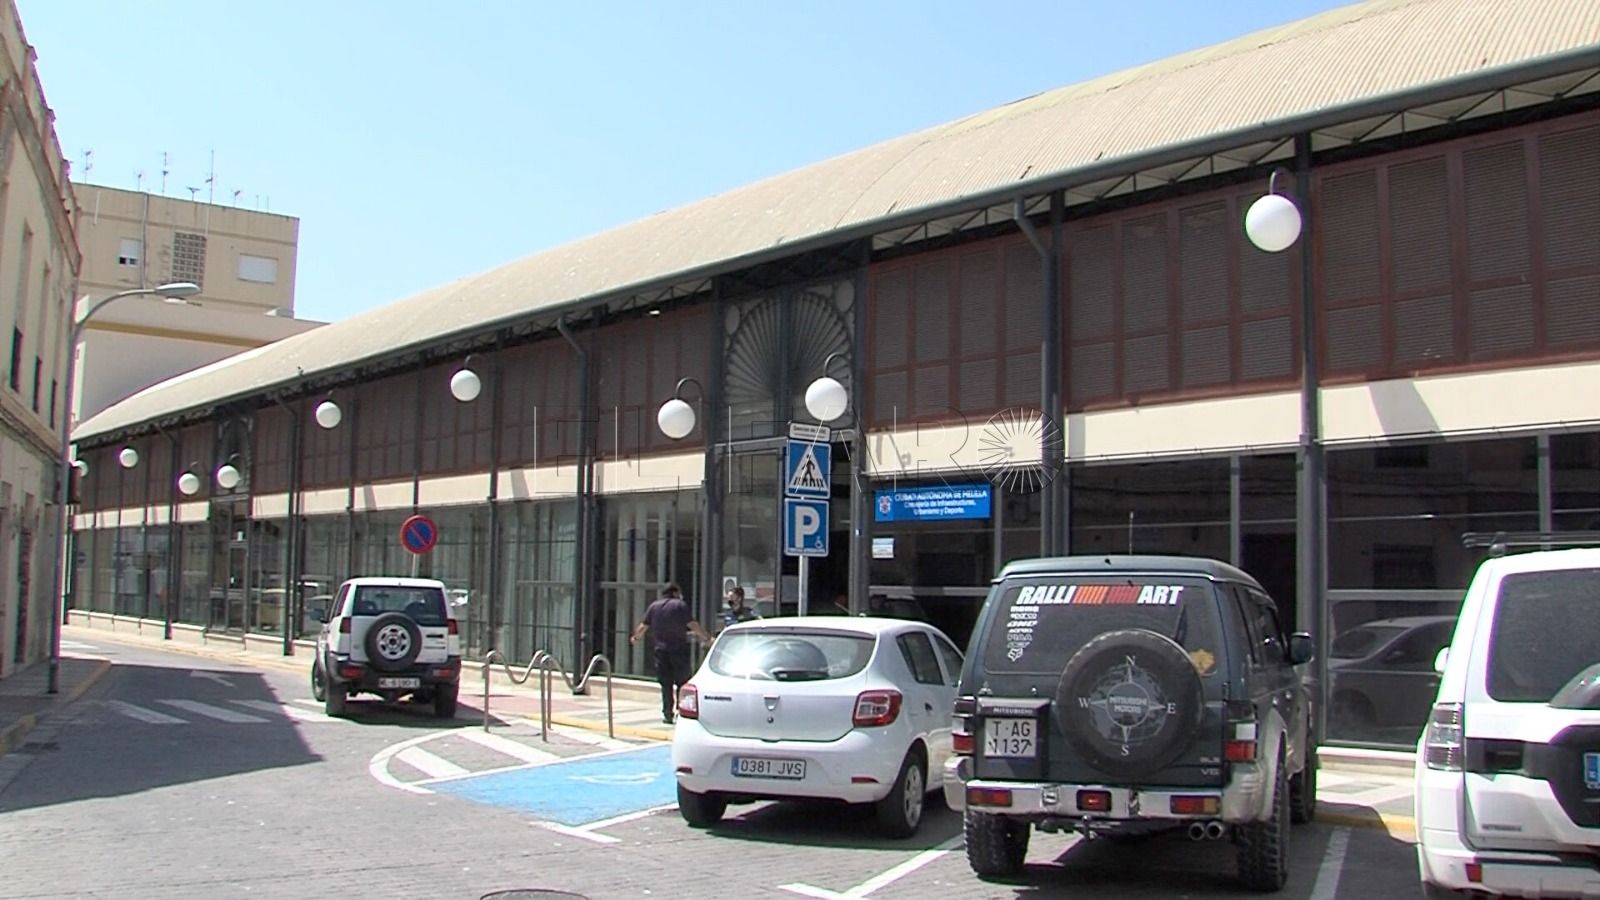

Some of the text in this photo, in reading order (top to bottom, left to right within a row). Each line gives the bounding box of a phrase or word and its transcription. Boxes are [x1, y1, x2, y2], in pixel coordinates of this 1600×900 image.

[962, 490, 987, 499] MELILLA
[795, 505, 821, 549] P
[1016, 585, 1184, 605] RALLI ART
[1126, 655, 1136, 666] N
[1078, 697, 1091, 708] W
[1167, 702, 1177, 714] E
[1120, 744, 1130, 756] S
[741, 759, 802, 775] 0381 JVS
